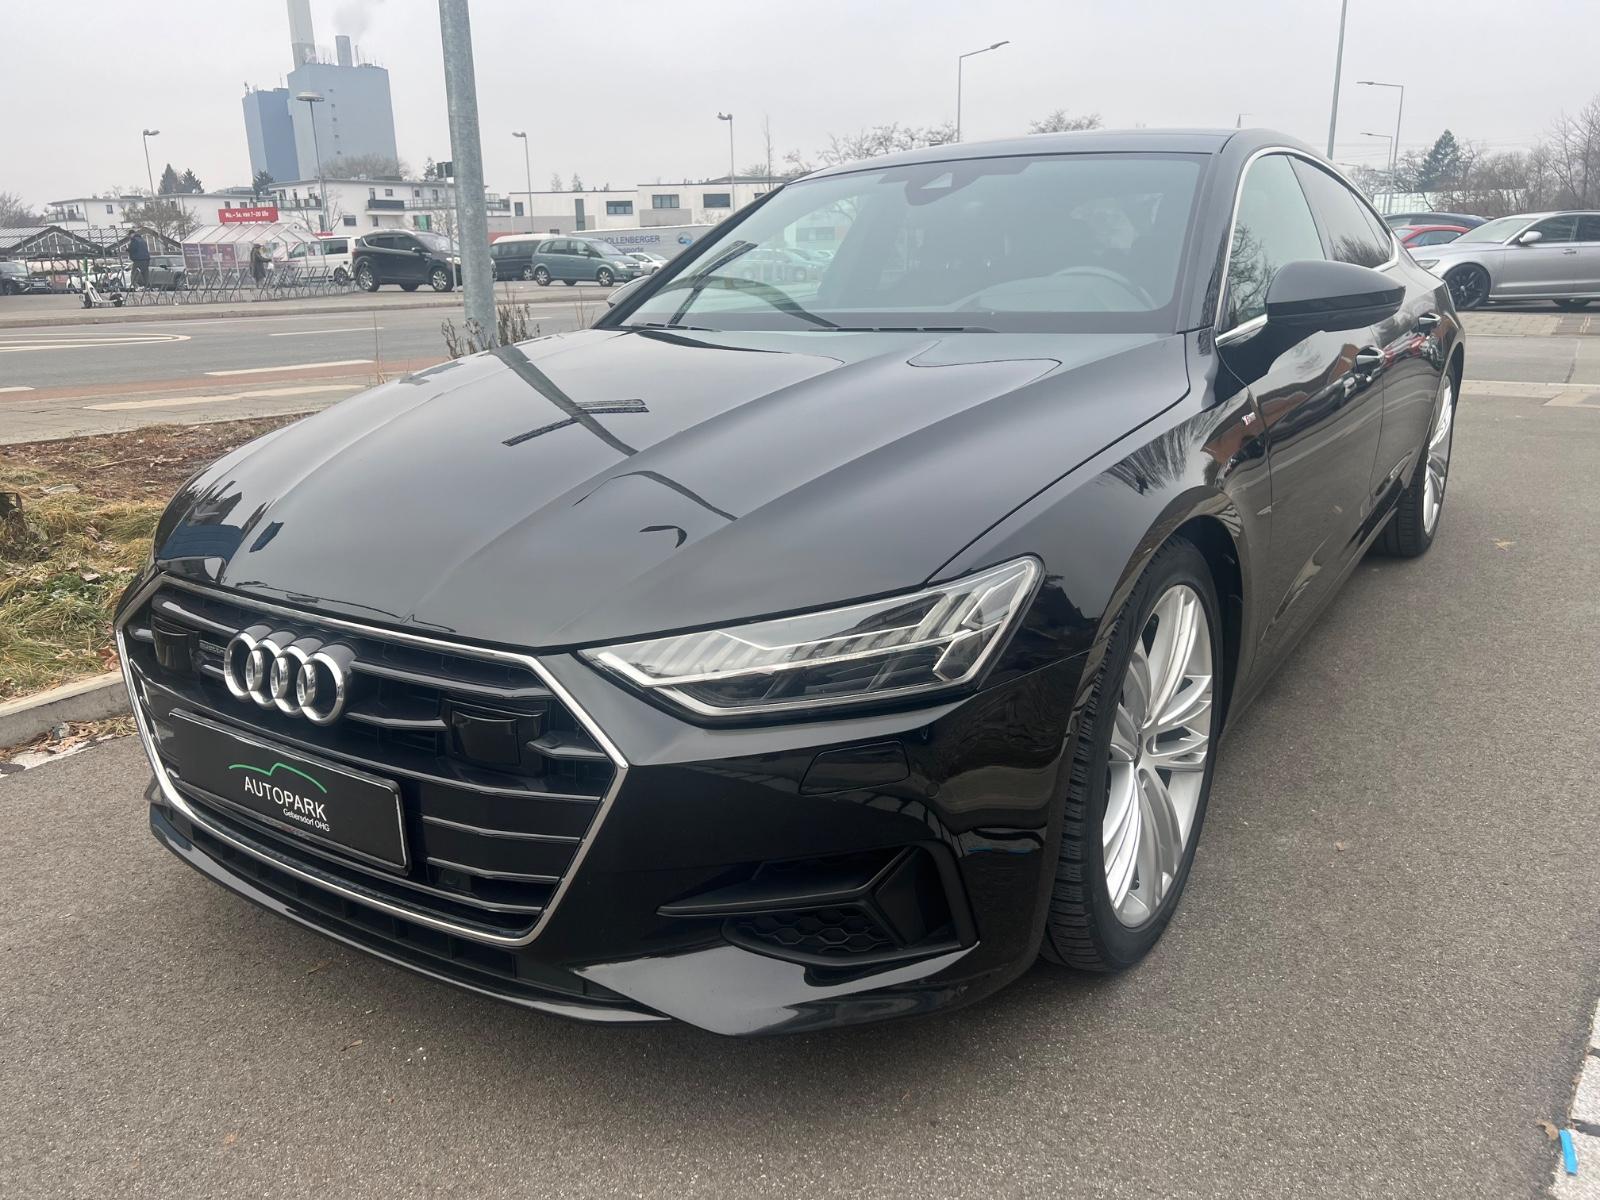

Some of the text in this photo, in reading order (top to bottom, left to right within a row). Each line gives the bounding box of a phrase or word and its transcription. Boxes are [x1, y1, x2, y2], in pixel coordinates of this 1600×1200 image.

[599, 235, 660, 245] HOLLENBERGER
[244, 776, 327, 821] AUTOPARK
[283, 808, 330, 832] Gebersdorf OHG
